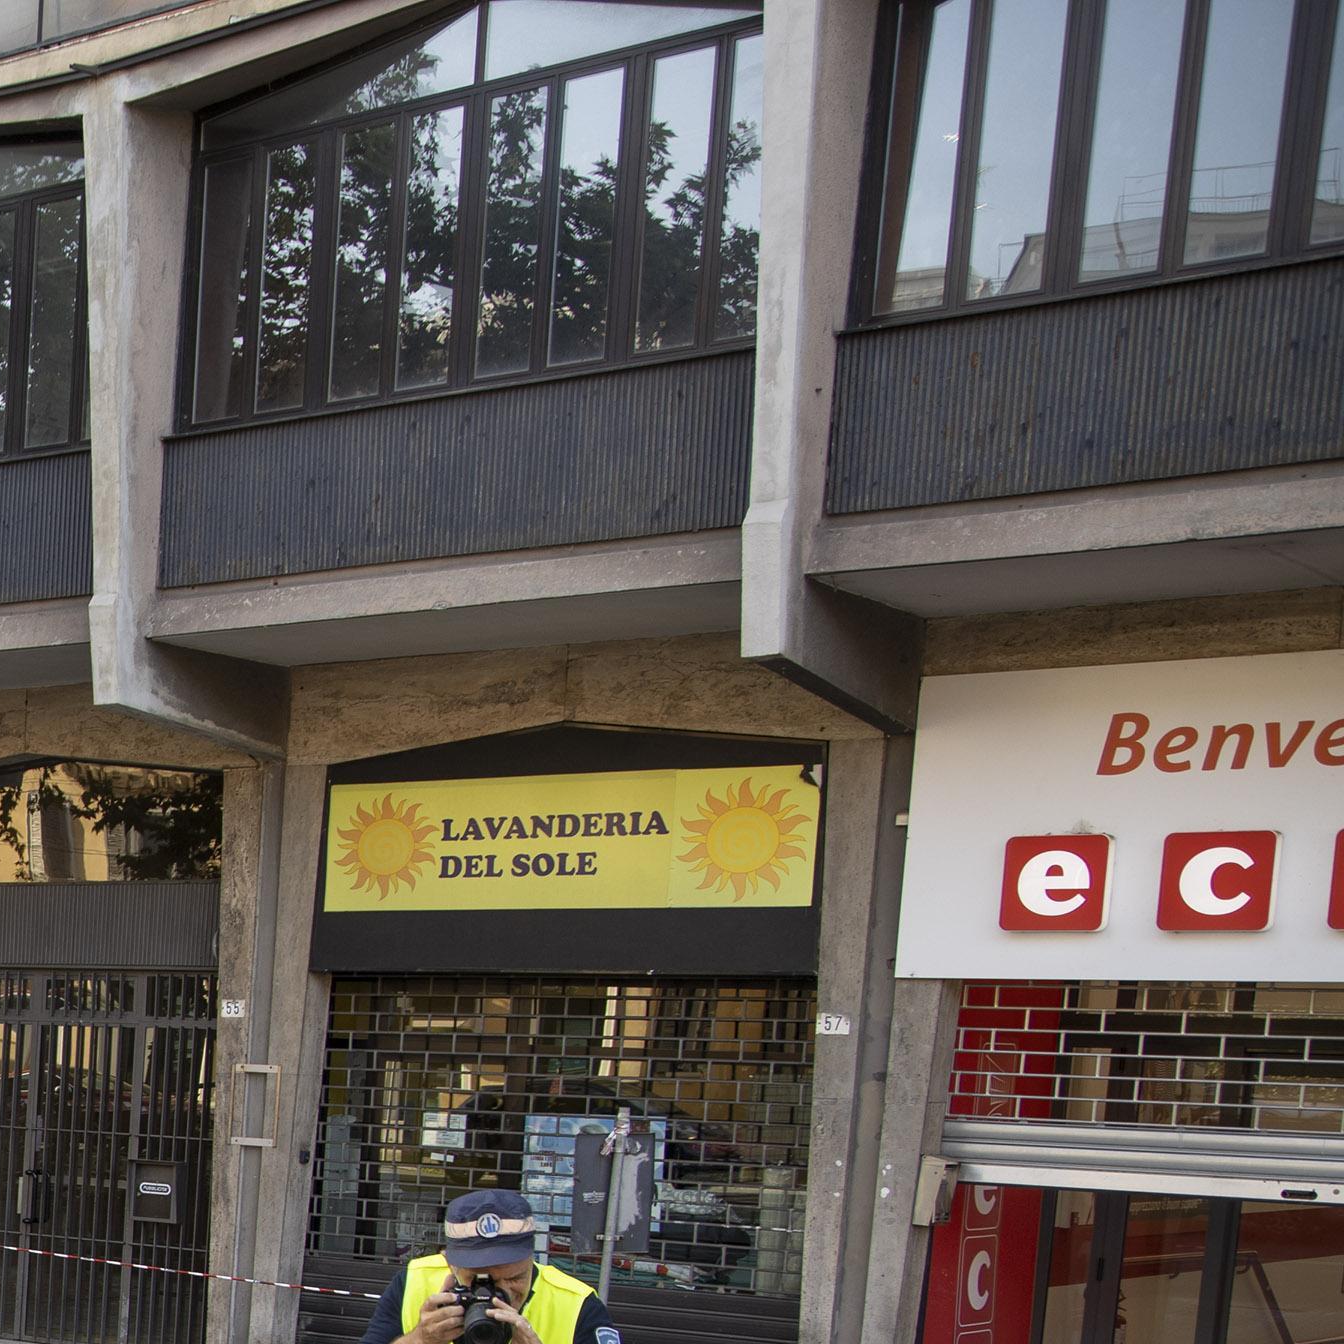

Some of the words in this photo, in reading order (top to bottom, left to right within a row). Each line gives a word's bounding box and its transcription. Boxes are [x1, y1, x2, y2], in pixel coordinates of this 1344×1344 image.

[441, 811, 669, 841] LAVANDERIA
[438, 855, 503, 878] DEL
[511, 852, 598, 877] SOLE
[226, 1001, 240, 1015] 55
[824, 1015, 843, 1032] 57
